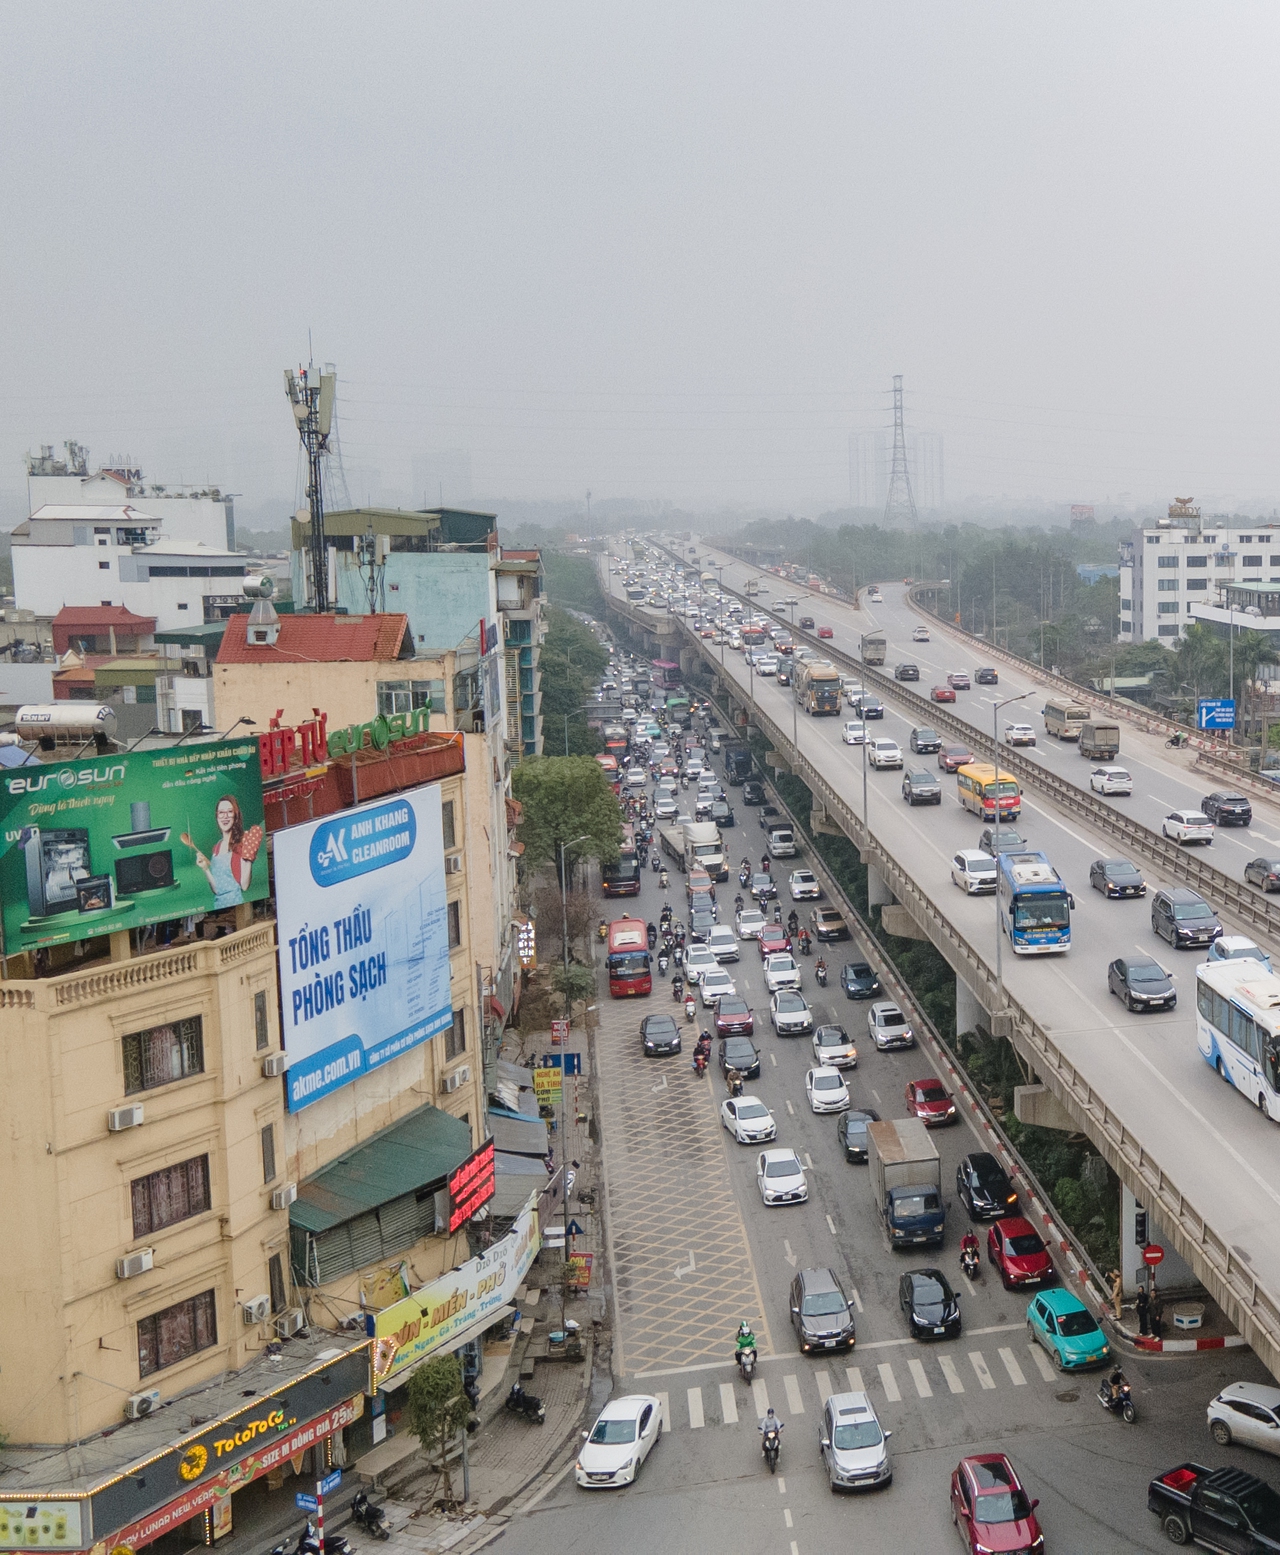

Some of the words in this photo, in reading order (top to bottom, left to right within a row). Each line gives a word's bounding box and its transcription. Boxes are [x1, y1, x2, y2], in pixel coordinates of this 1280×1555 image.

[259, 709, 295, 777] BẾP
[8, 764, 125, 794] eurosun
[351, 819, 373, 840] ANH
[375, 808, 408, 832] KHANG
[352, 831, 410, 864] CLEANROOM
[288, 922, 330, 974] TỔNG
[334, 904, 372, 955] THẦU
[292, 972, 345, 1026] PHÒNG
[349, 951, 387, 1001] SẠCH
[293, 1049, 361, 1101] akme.com.vn
[431, 1287, 469, 1329] MIẾN
[477, 1262, 507, 1300] PHỞ
[414, 1334, 436, 1354] Ngan
[262, 1448, 280, 1468] SIZE
[282, 1443, 290, 1457] M
[140, 1514, 171, 1538] LUNAR
[172, 1503, 192, 1520] NEW
[192, 1488, 215, 1507] YEAR
